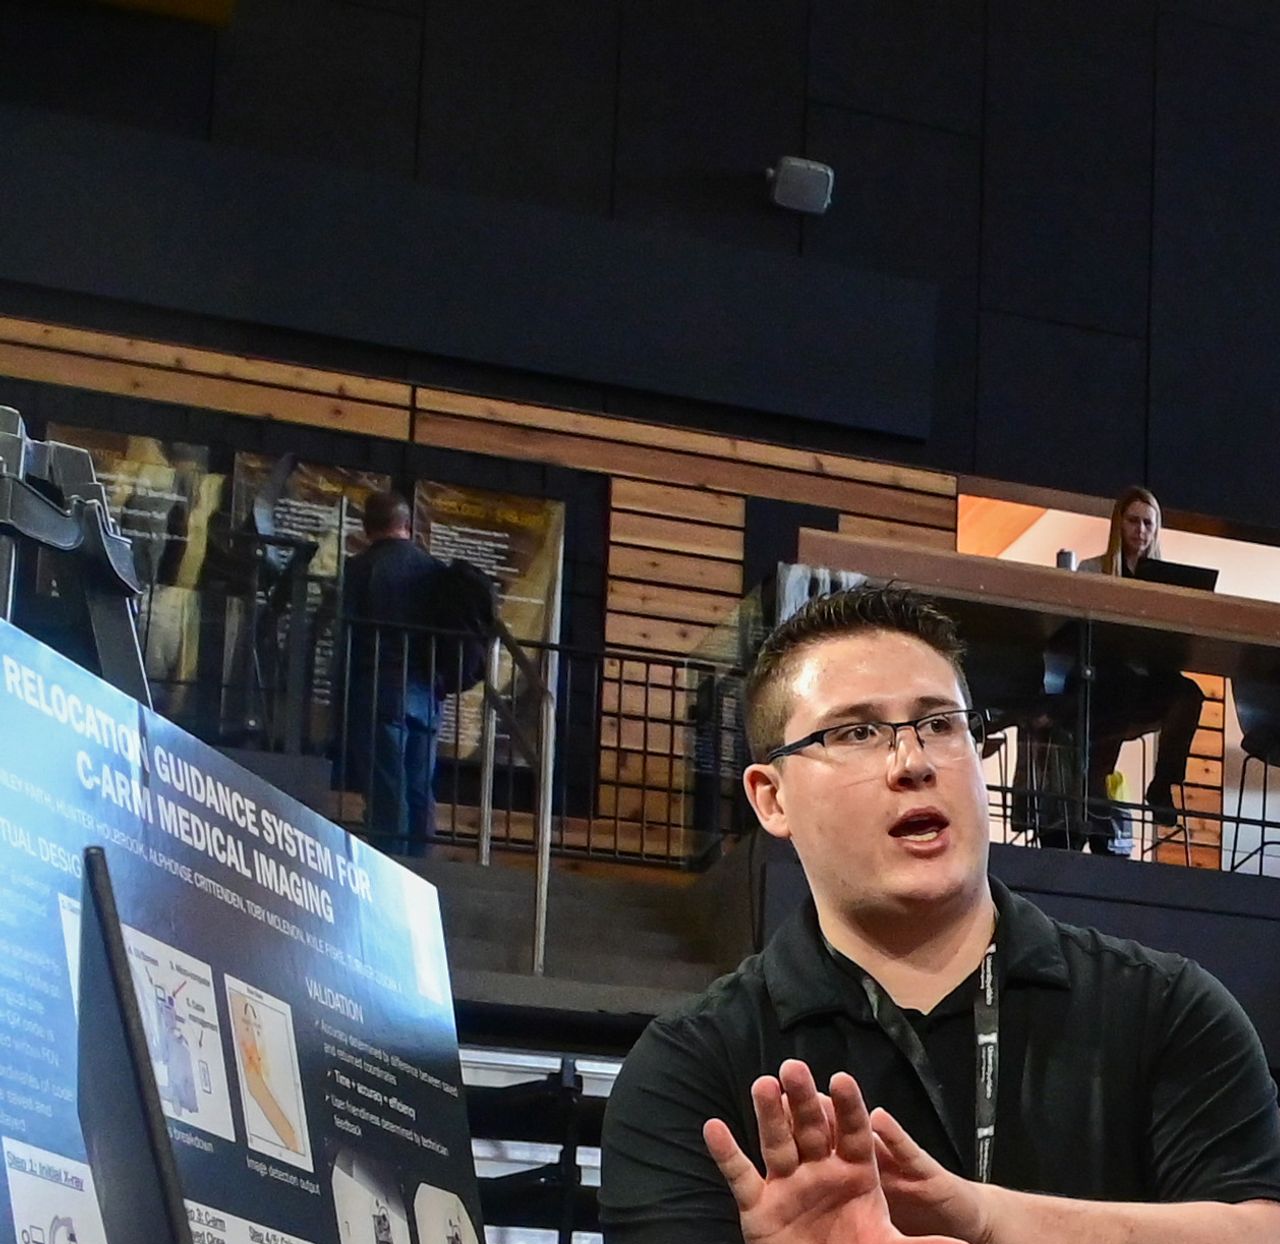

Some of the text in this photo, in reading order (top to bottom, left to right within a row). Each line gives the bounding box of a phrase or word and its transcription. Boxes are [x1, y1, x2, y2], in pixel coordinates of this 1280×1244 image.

[3, 654, 372, 901] RELOCATION GUIDANCE SYSTEM FOR
[37, 836, 83, 880] DESIG
[76, 750, 335, 924] C-ARM MEDICAL IMAGING
[304, 976, 364, 1025] VALIDATION
